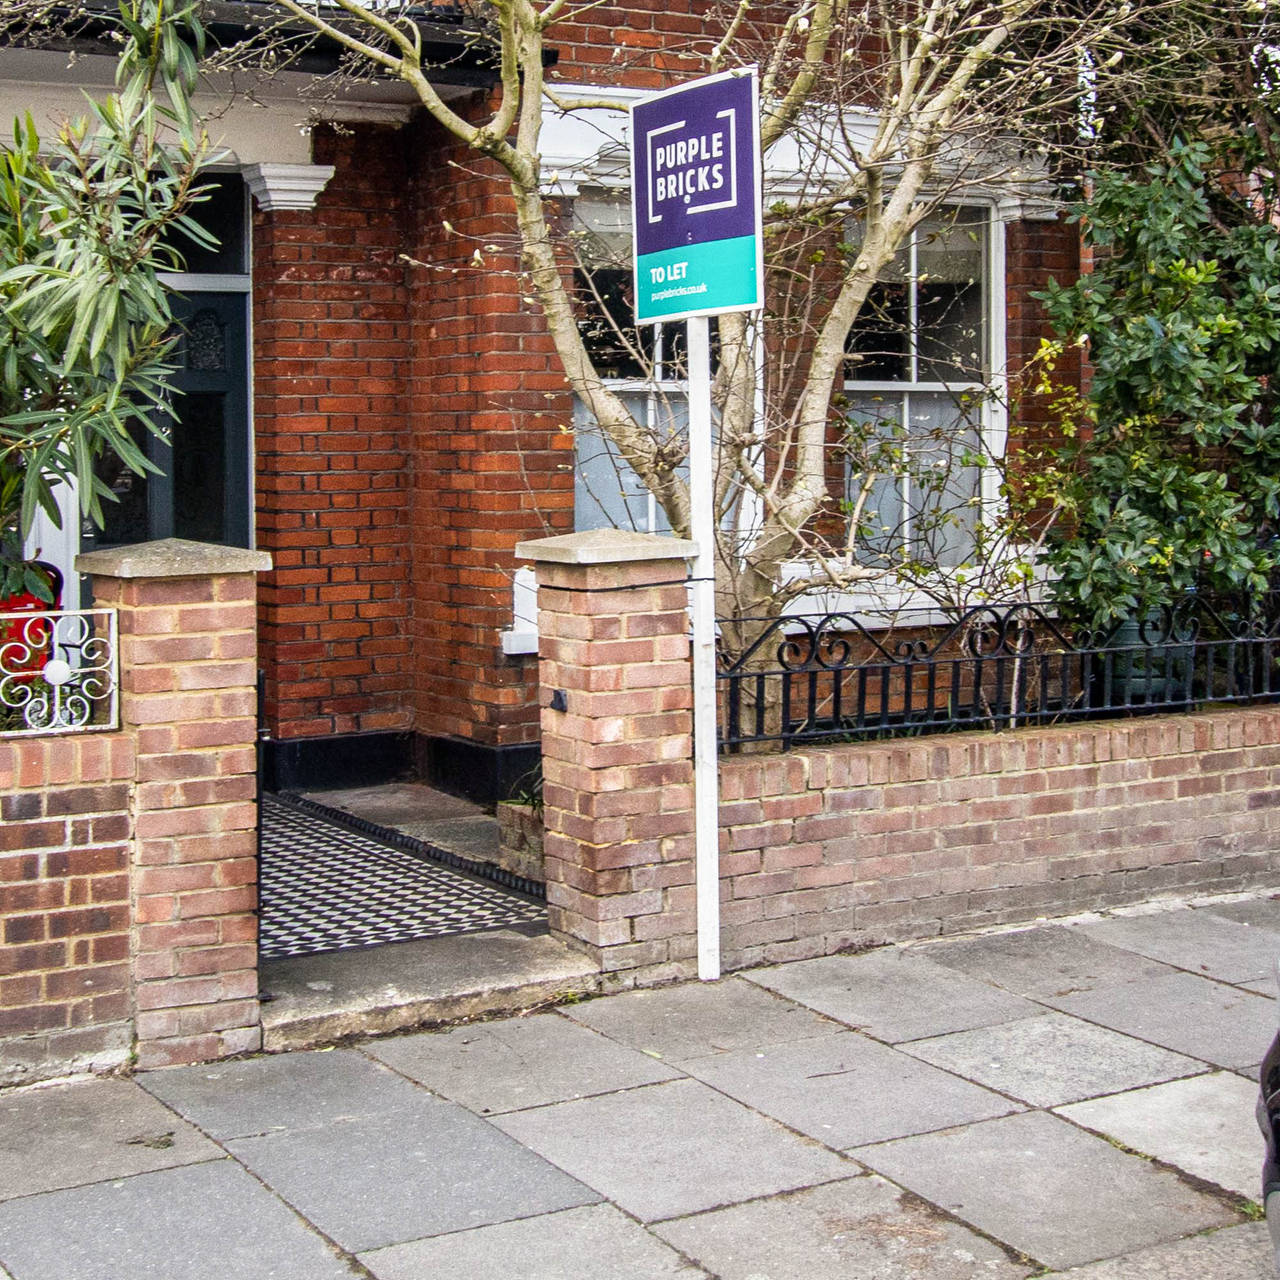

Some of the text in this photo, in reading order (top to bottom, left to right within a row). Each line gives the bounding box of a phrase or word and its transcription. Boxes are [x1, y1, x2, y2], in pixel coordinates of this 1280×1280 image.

[656, 132, 723, 172] PURPLE
[656, 163, 724, 202] BRICKS
[650, 261, 688, 284] TO LET
